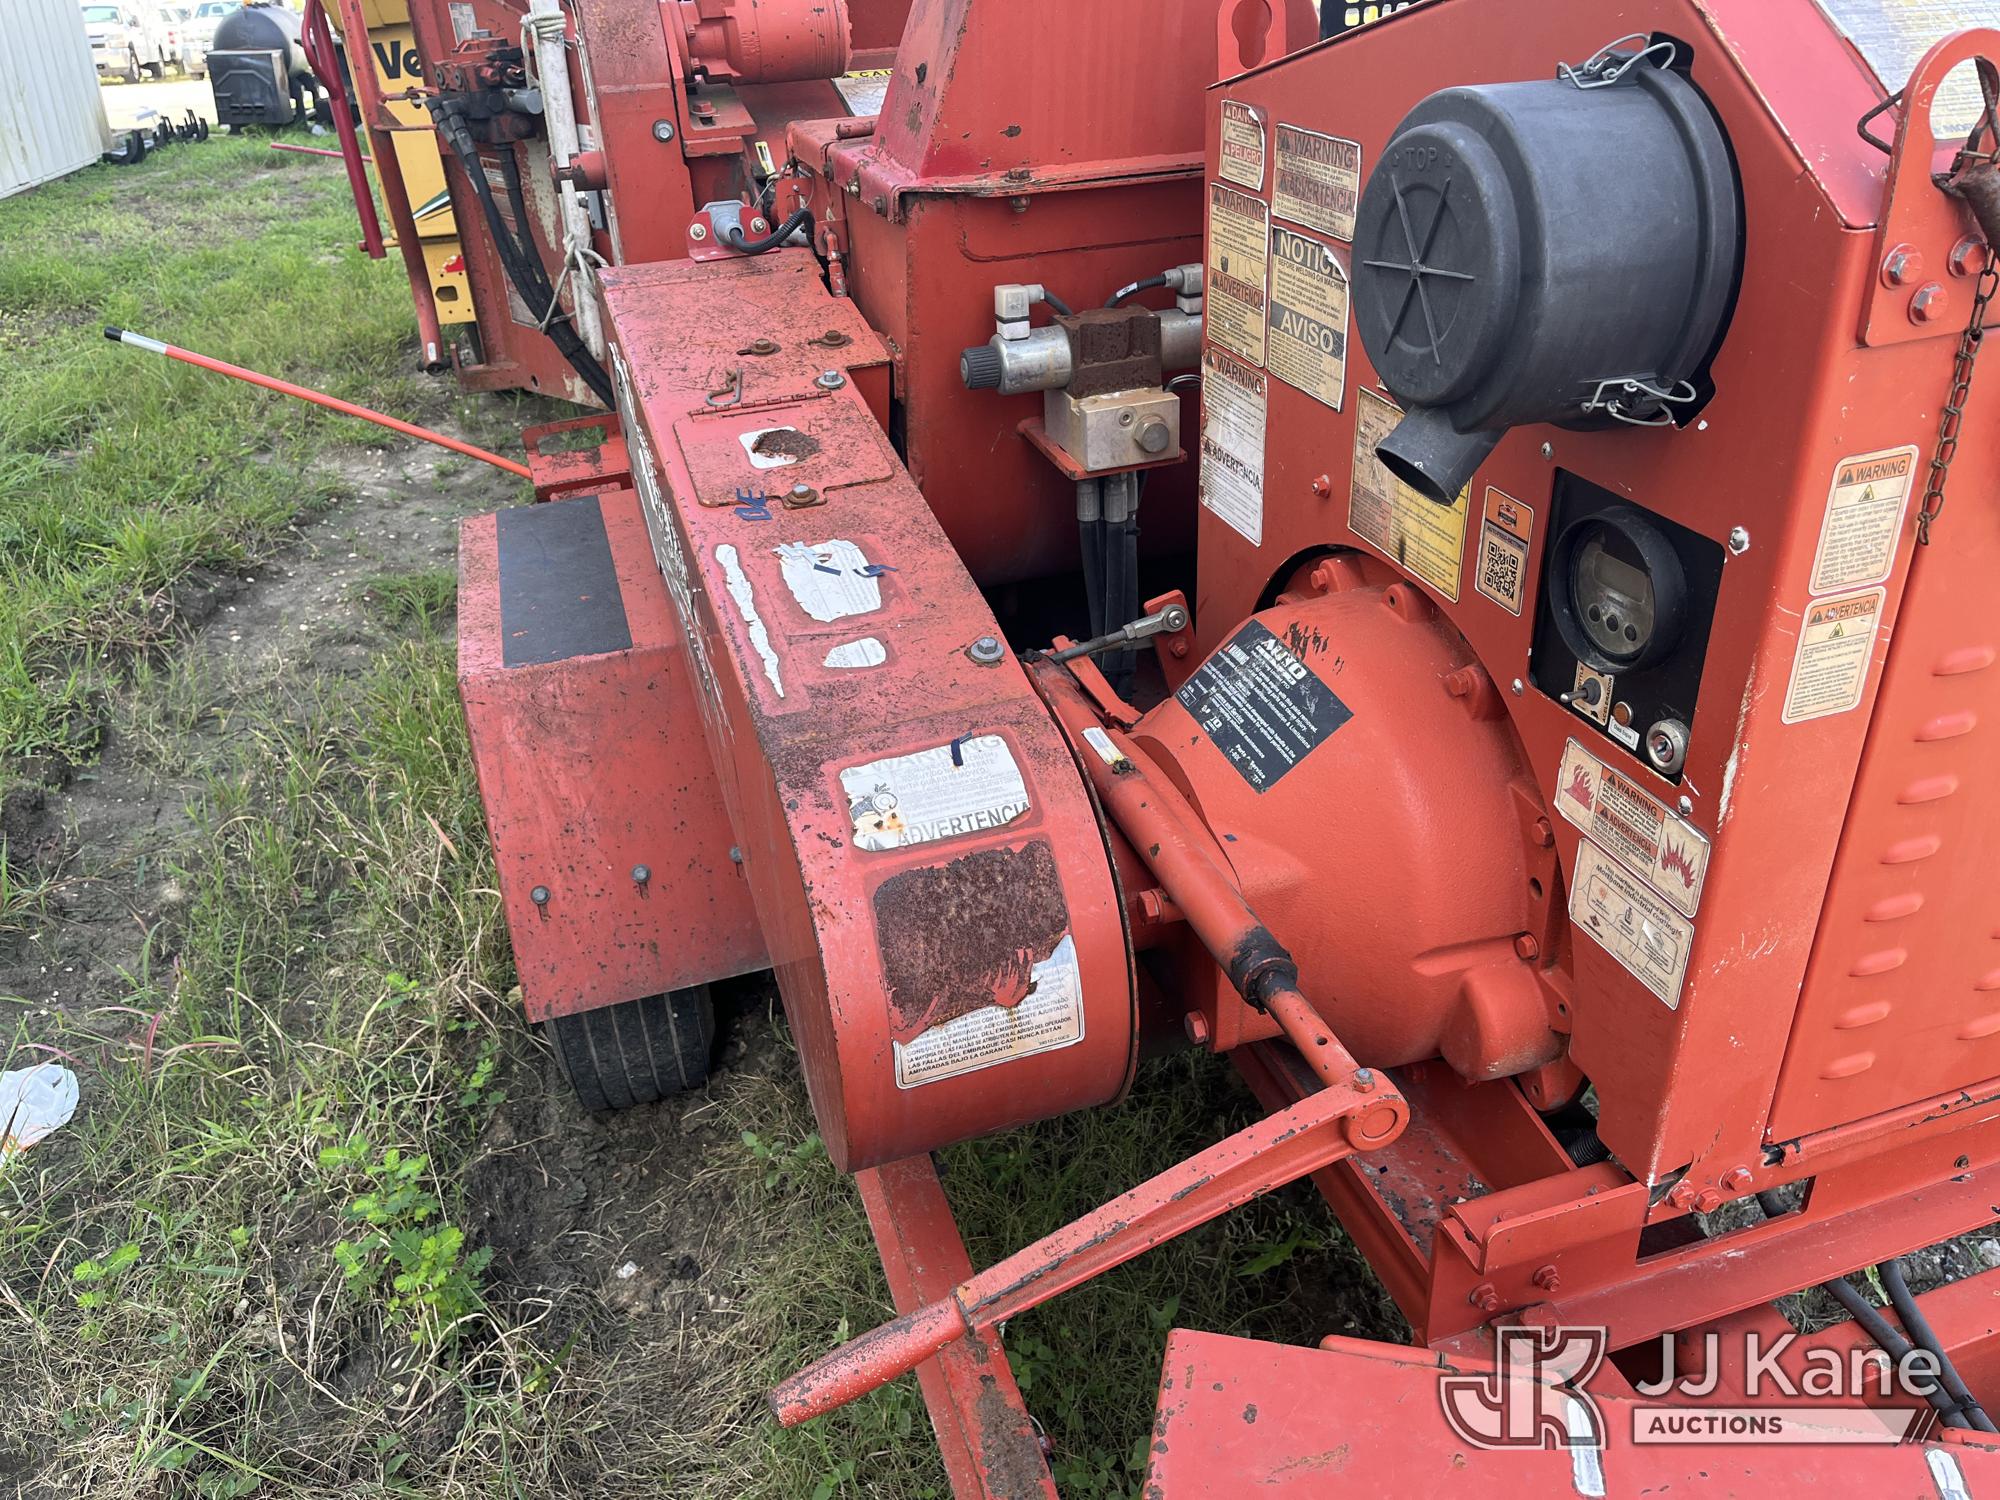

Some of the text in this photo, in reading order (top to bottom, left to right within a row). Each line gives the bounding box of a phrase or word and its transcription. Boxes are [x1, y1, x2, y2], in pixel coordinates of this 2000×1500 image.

[1230, 145, 1261, 164] PELIGRO
[1294, 134, 1353, 168] WARNING
[1405, 147, 1438, 171] TOP
[1223, 190, 1265, 220] WARNING
[1220, 277, 1264, 309] ADVERTENCIA
[1281, 311, 1333, 352] AVISO
[1217, 356, 1261, 395] WARNING
[1212, 445, 1260, 489] ADVERTENCIA
[1856, 460, 1906, 481] WARNING
[1824, 599, 1876, 620] ADVERTENCIA
[1230, 707, 1245, 723] Service
[1266, 701, 1288, 723] Information
[1287, 725, 1311, 749] Limitations
[1278, 700, 1286, 708] can
[1283, 707, 1297, 720] cause
[1293, 718, 1308, 732] injury.
[1284, 697, 1293, 706] this
[1290, 704, 1302, 716] plate
[1298, 713, 1319, 733] removed.
[871, 735, 1001, 771] WARNNG
[1234, 742, 1248, 757] Parts
[1243, 734, 1265, 759] maintenance
[1265, 725, 1275, 735] with
[1272, 733, 1286, 748] handle
[1287, 749, 1296, 758] the
[1269, 739, 1294, 765] performance.
[1616, 780, 1657, 817] WARNING
[897, 803, 1030, 847] ADVERTENCIA
[1609, 813, 1652, 853] ADVERTENCIA
[1623, 885, 1652, 915] industrial
[948, 1025, 982, 1039] EMBRAGUE
[983, 1011, 1034, 1029] ADECUADAMENTE
[981, 1015, 992, 1023] CON
[906, 1043, 939, 1056] CONSULTE
[952, 1032, 979, 1045] MANUAL
[980, 1029, 993, 1037] DEL
[907, 1022, 1061, 1069] LAS FALLAS DEL EMBRAGUE CASI NUNCA ESTÁN
[955, 1041, 974, 1050] FALLAS
[1016, 1025, 1034, 1035] ABUSO
[1034, 1022, 1044, 1030] DEL
[908, 1060, 949, 1076] AMPARADAS
[950, 1055, 968, 1064] BAJO
